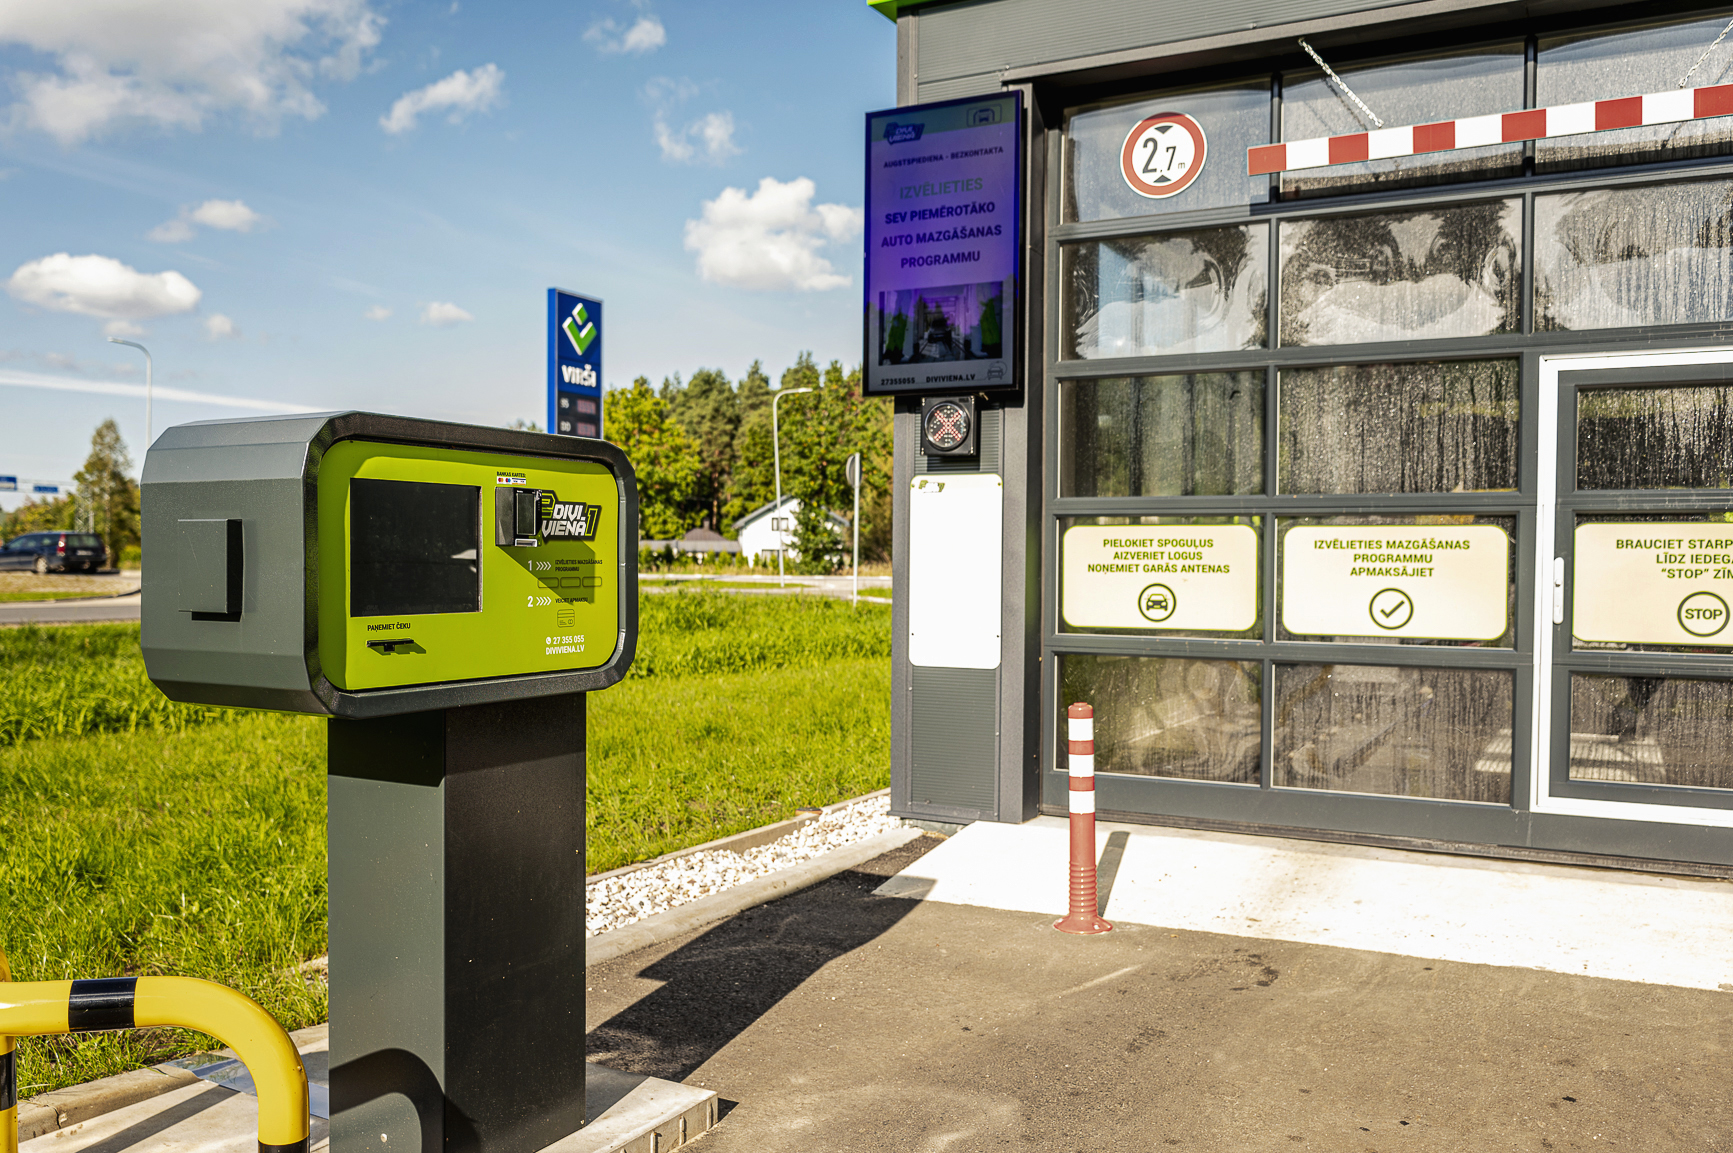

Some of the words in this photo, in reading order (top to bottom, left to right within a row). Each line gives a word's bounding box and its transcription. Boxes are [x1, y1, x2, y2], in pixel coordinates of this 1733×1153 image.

[883, 154, 944, 169] AUGSTSPIEDIENA
[950, 146, 1003, 160] BEZKONTAKTA
[1142, 137, 1176, 174] 2.7
[900, 177, 983, 199] IZVĒLIETIES
[885, 211, 907, 225] SEV
[910, 202, 995, 222] PIEMĒROTĀKO
[881, 234, 913, 248] AUTO
[915, 224, 1002, 244] MAZGĀŠANAS
[900, 251, 981, 268] PROGRAMMU
[881, 377, 916, 386] 27355055
[925, 373, 976, 383] DIVIVIENA.LV
[1103, 538, 1154, 548] PIELOKIET
[1157, 538, 1214, 550] SPOGUĻUS
[1314, 538, 1383, 549] IZVĒLIETIES
[1386, 537, 1470, 550] MAZGĀŠANAS
[1616, 539, 1684, 549] BRAUCIET
[1113, 551, 1165, 561] AIZVERIET
[1168, 551, 1203, 561] LOGUS
[1353, 553, 1433, 564] PROGRAMMU
[1656, 552, 1686, 564] LĪDZ
[1690, 554, 1733, 564] IEDEG
[1087, 563, 1140, 575] NOŅEMIET
[1143, 562, 1178, 573] GARĀS
[1180, 564, 1230, 574] ANTENAS
[1350, 565, 1435, 577] APMAKSĀJIET
[527, 595, 534, 607] 2
[1684, 608, 1723, 620] STOP
[367, 623, 395, 632] PAŅEMIET
[396, 621, 411, 630] ČEKU
[553, 636, 561, 645] 27
[561, 635, 573, 644] 355
[573, 634, 585, 643] 055
[545, 644, 585, 655] DIVIVIENA.LV
